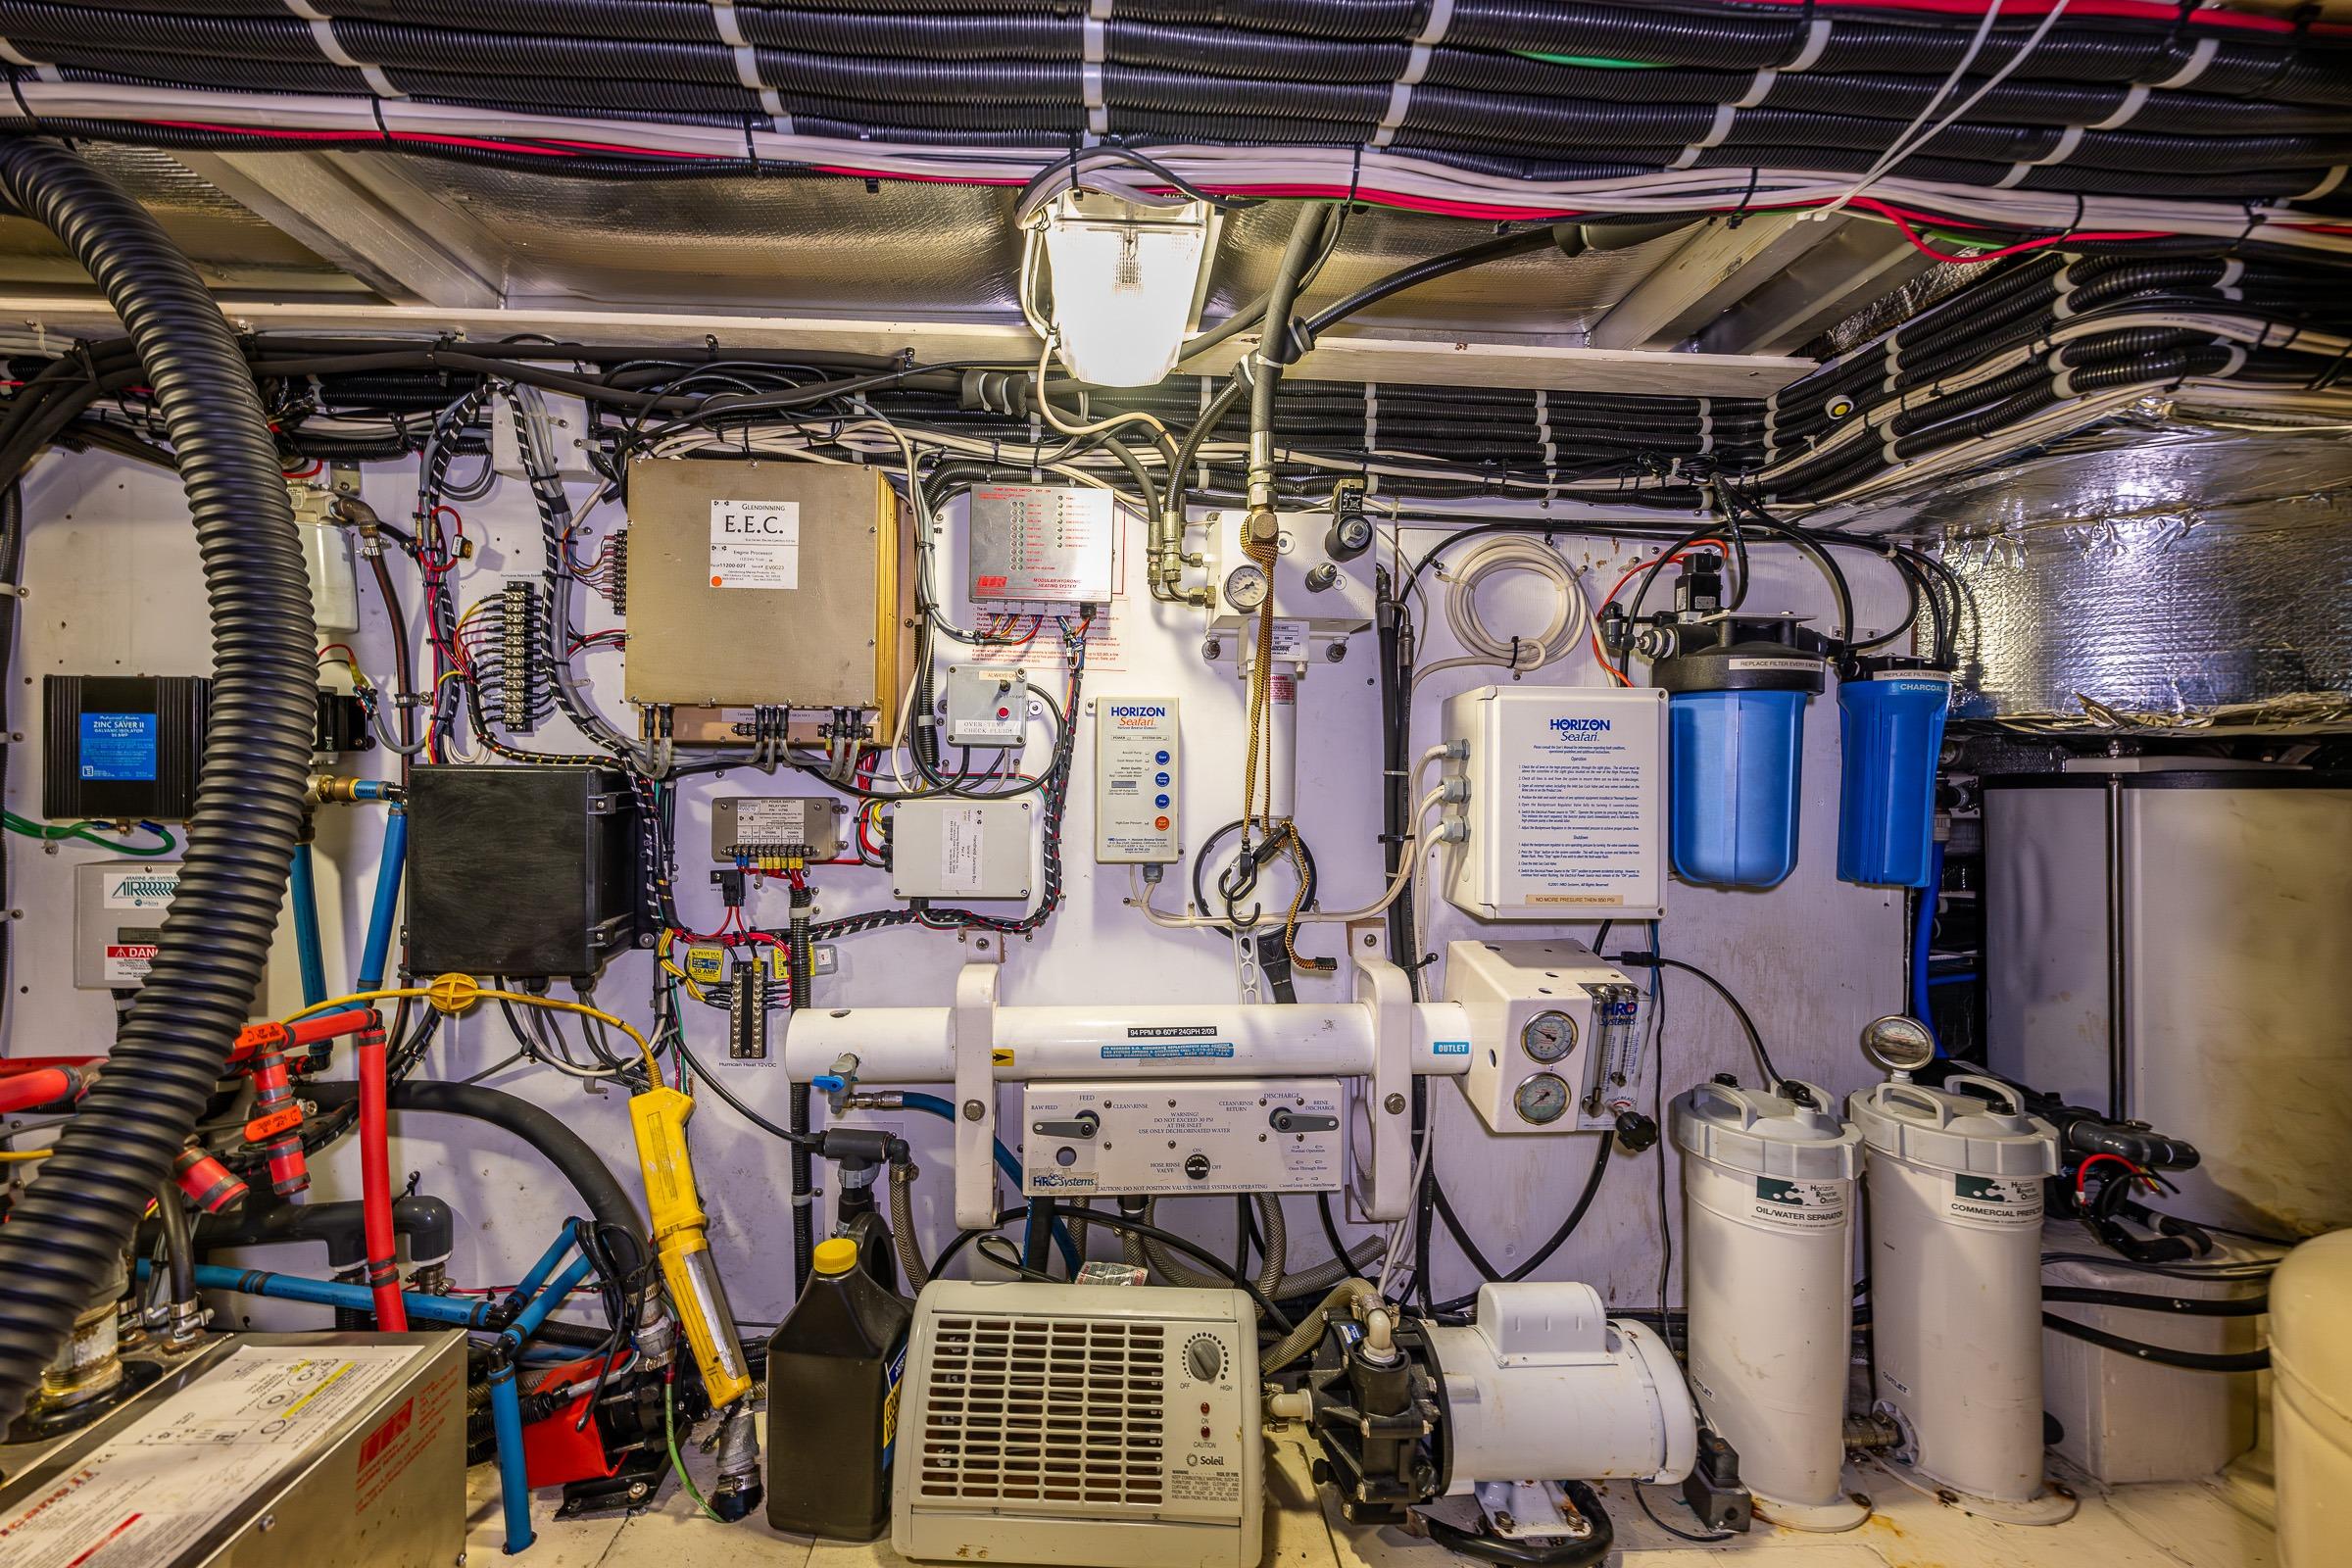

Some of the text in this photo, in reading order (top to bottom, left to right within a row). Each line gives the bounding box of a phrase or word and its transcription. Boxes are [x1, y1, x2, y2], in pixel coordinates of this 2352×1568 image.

[725, 515, 784, 534] E.E.C.
[1111, 707, 1165, 717] HORIZON
[1120, 717, 1154, 725] Seafari
[1550, 719, 1610, 731] HORIZON
[1561, 731, 1598, 741] Seafari
[1603, 1002, 1638, 1016] HRO
[1059, 1176, 1094, 1187] Systems
[1756, 1206, 1805, 1220] OIL/WATER
[1952, 1203, 2015, 1217] COMMERCIAL
[1200, 1456, 1224, 1465] Soleil
